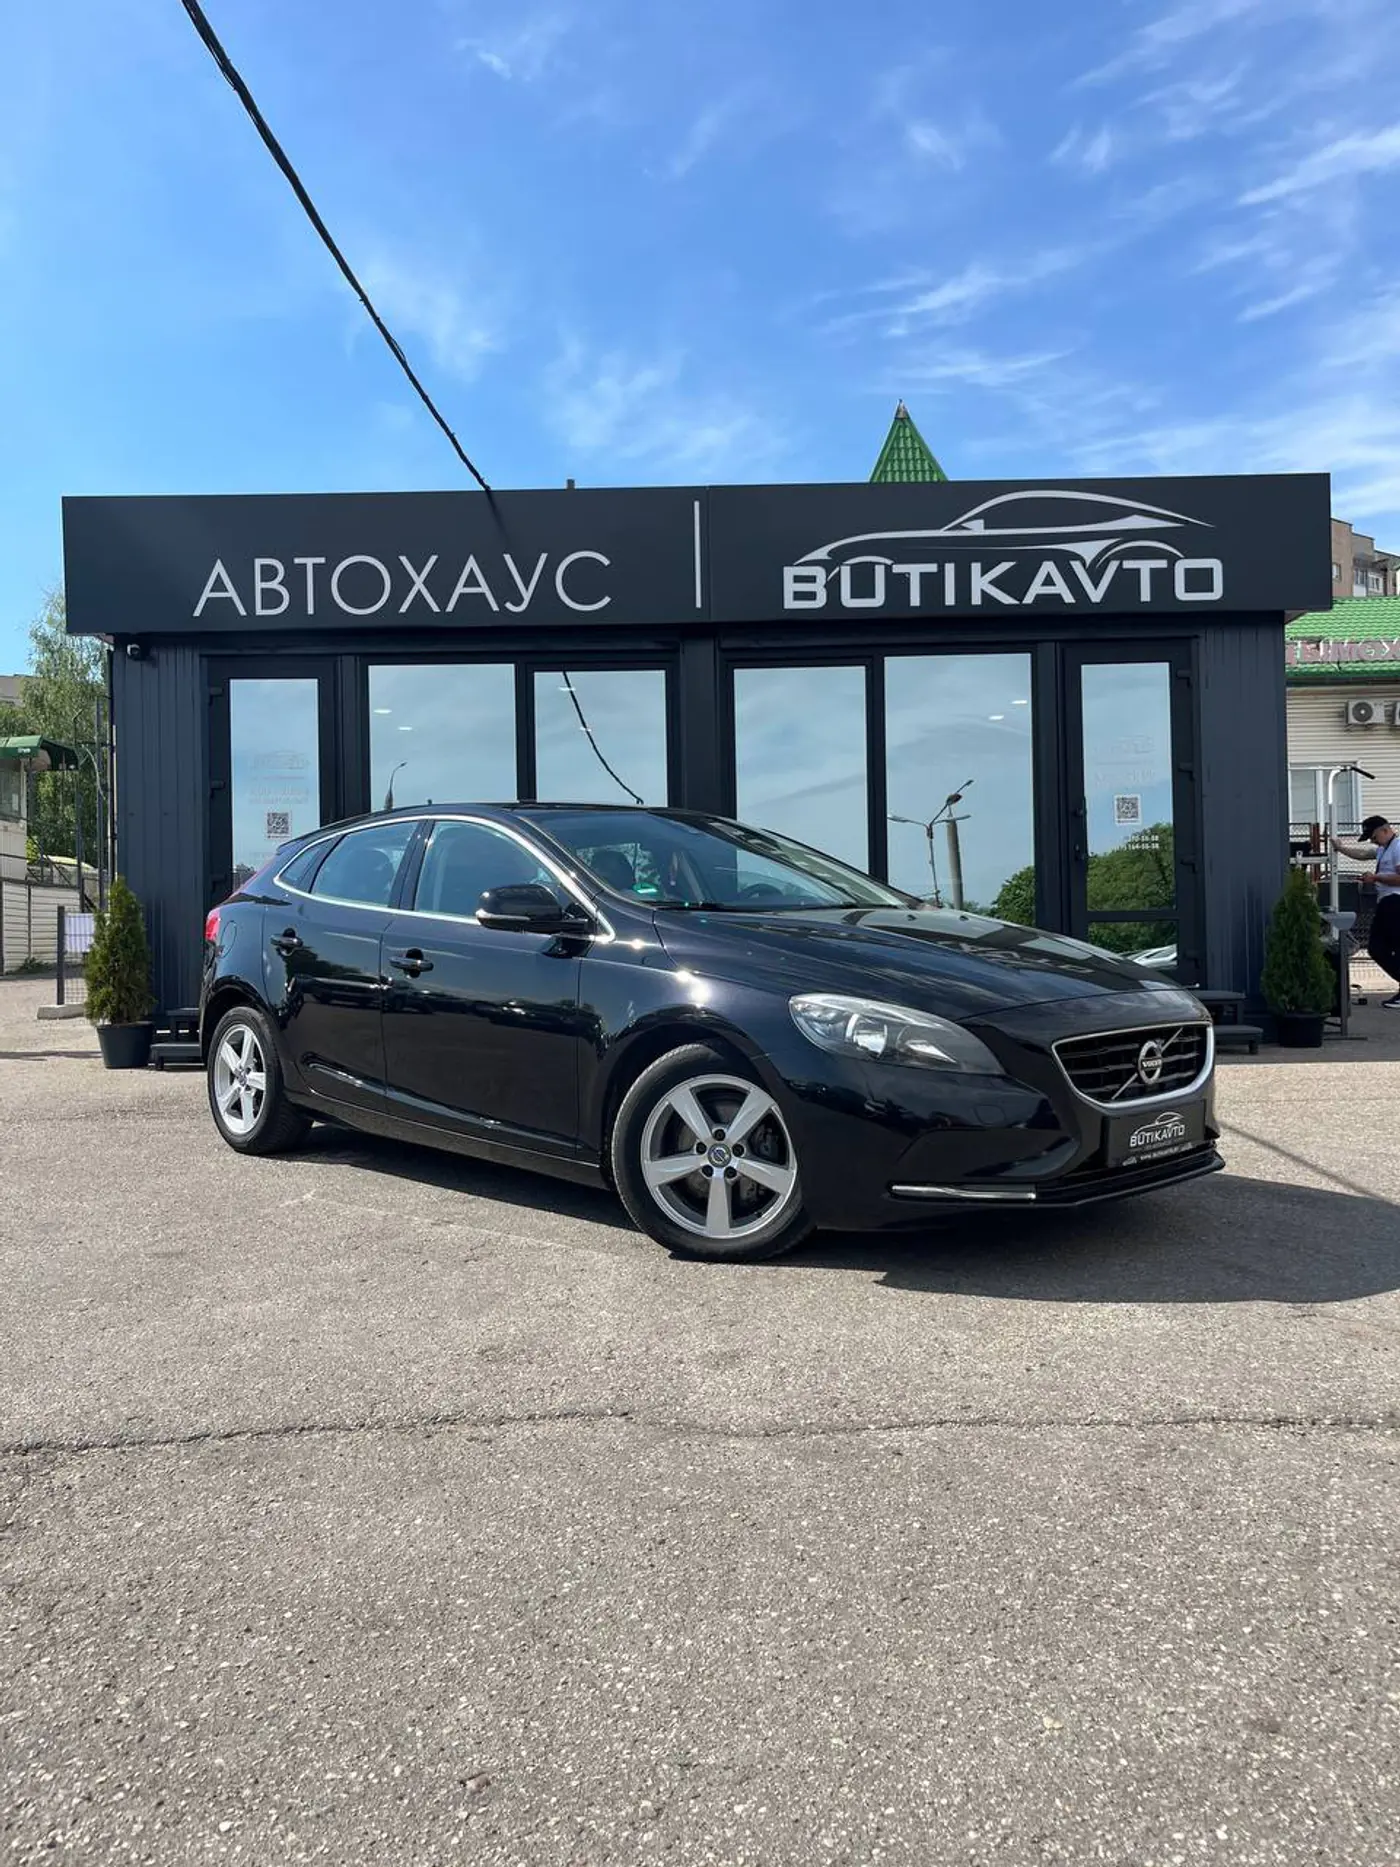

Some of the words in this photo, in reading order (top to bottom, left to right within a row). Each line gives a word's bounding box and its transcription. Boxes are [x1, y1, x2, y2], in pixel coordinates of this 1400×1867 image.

[193, 550, 612, 617] АВТОХАУС
[782, 557, 1224, 610] BUTIKAVTO
[1129, 1124, 1185, 1147] BUTIKAVTO
